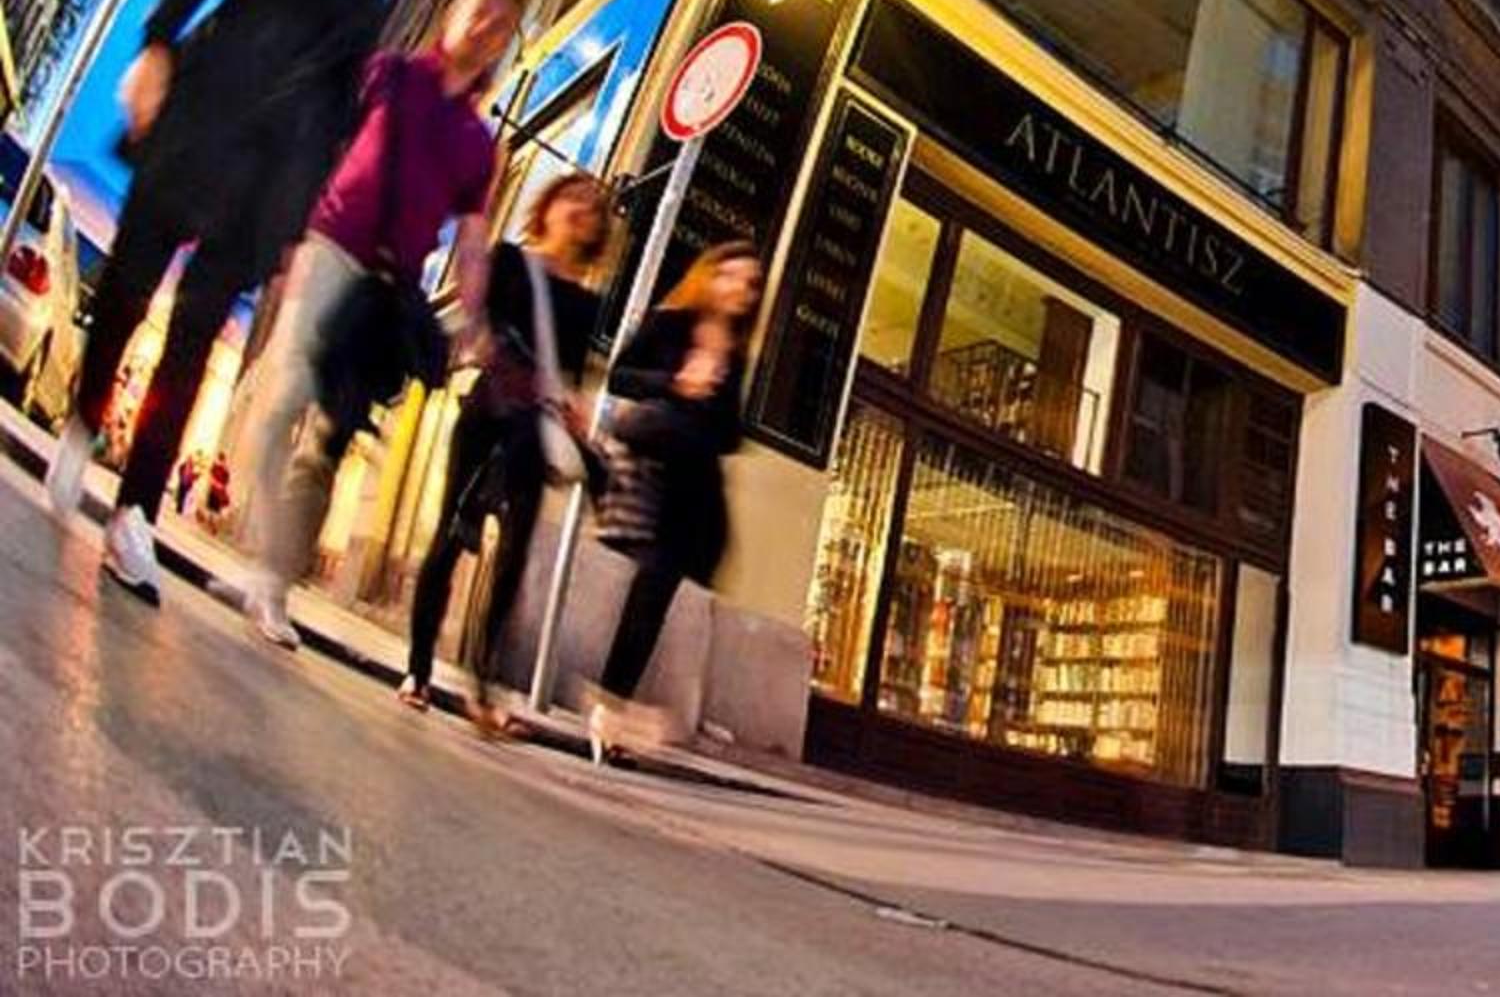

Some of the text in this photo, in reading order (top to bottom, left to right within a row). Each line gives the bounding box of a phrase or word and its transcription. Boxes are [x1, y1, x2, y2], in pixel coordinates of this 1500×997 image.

[1004, 113, 1246, 295] ATLANTISZ
[1423, 538, 1467, 555] THE
[1423, 557, 1467, 576] BAR
